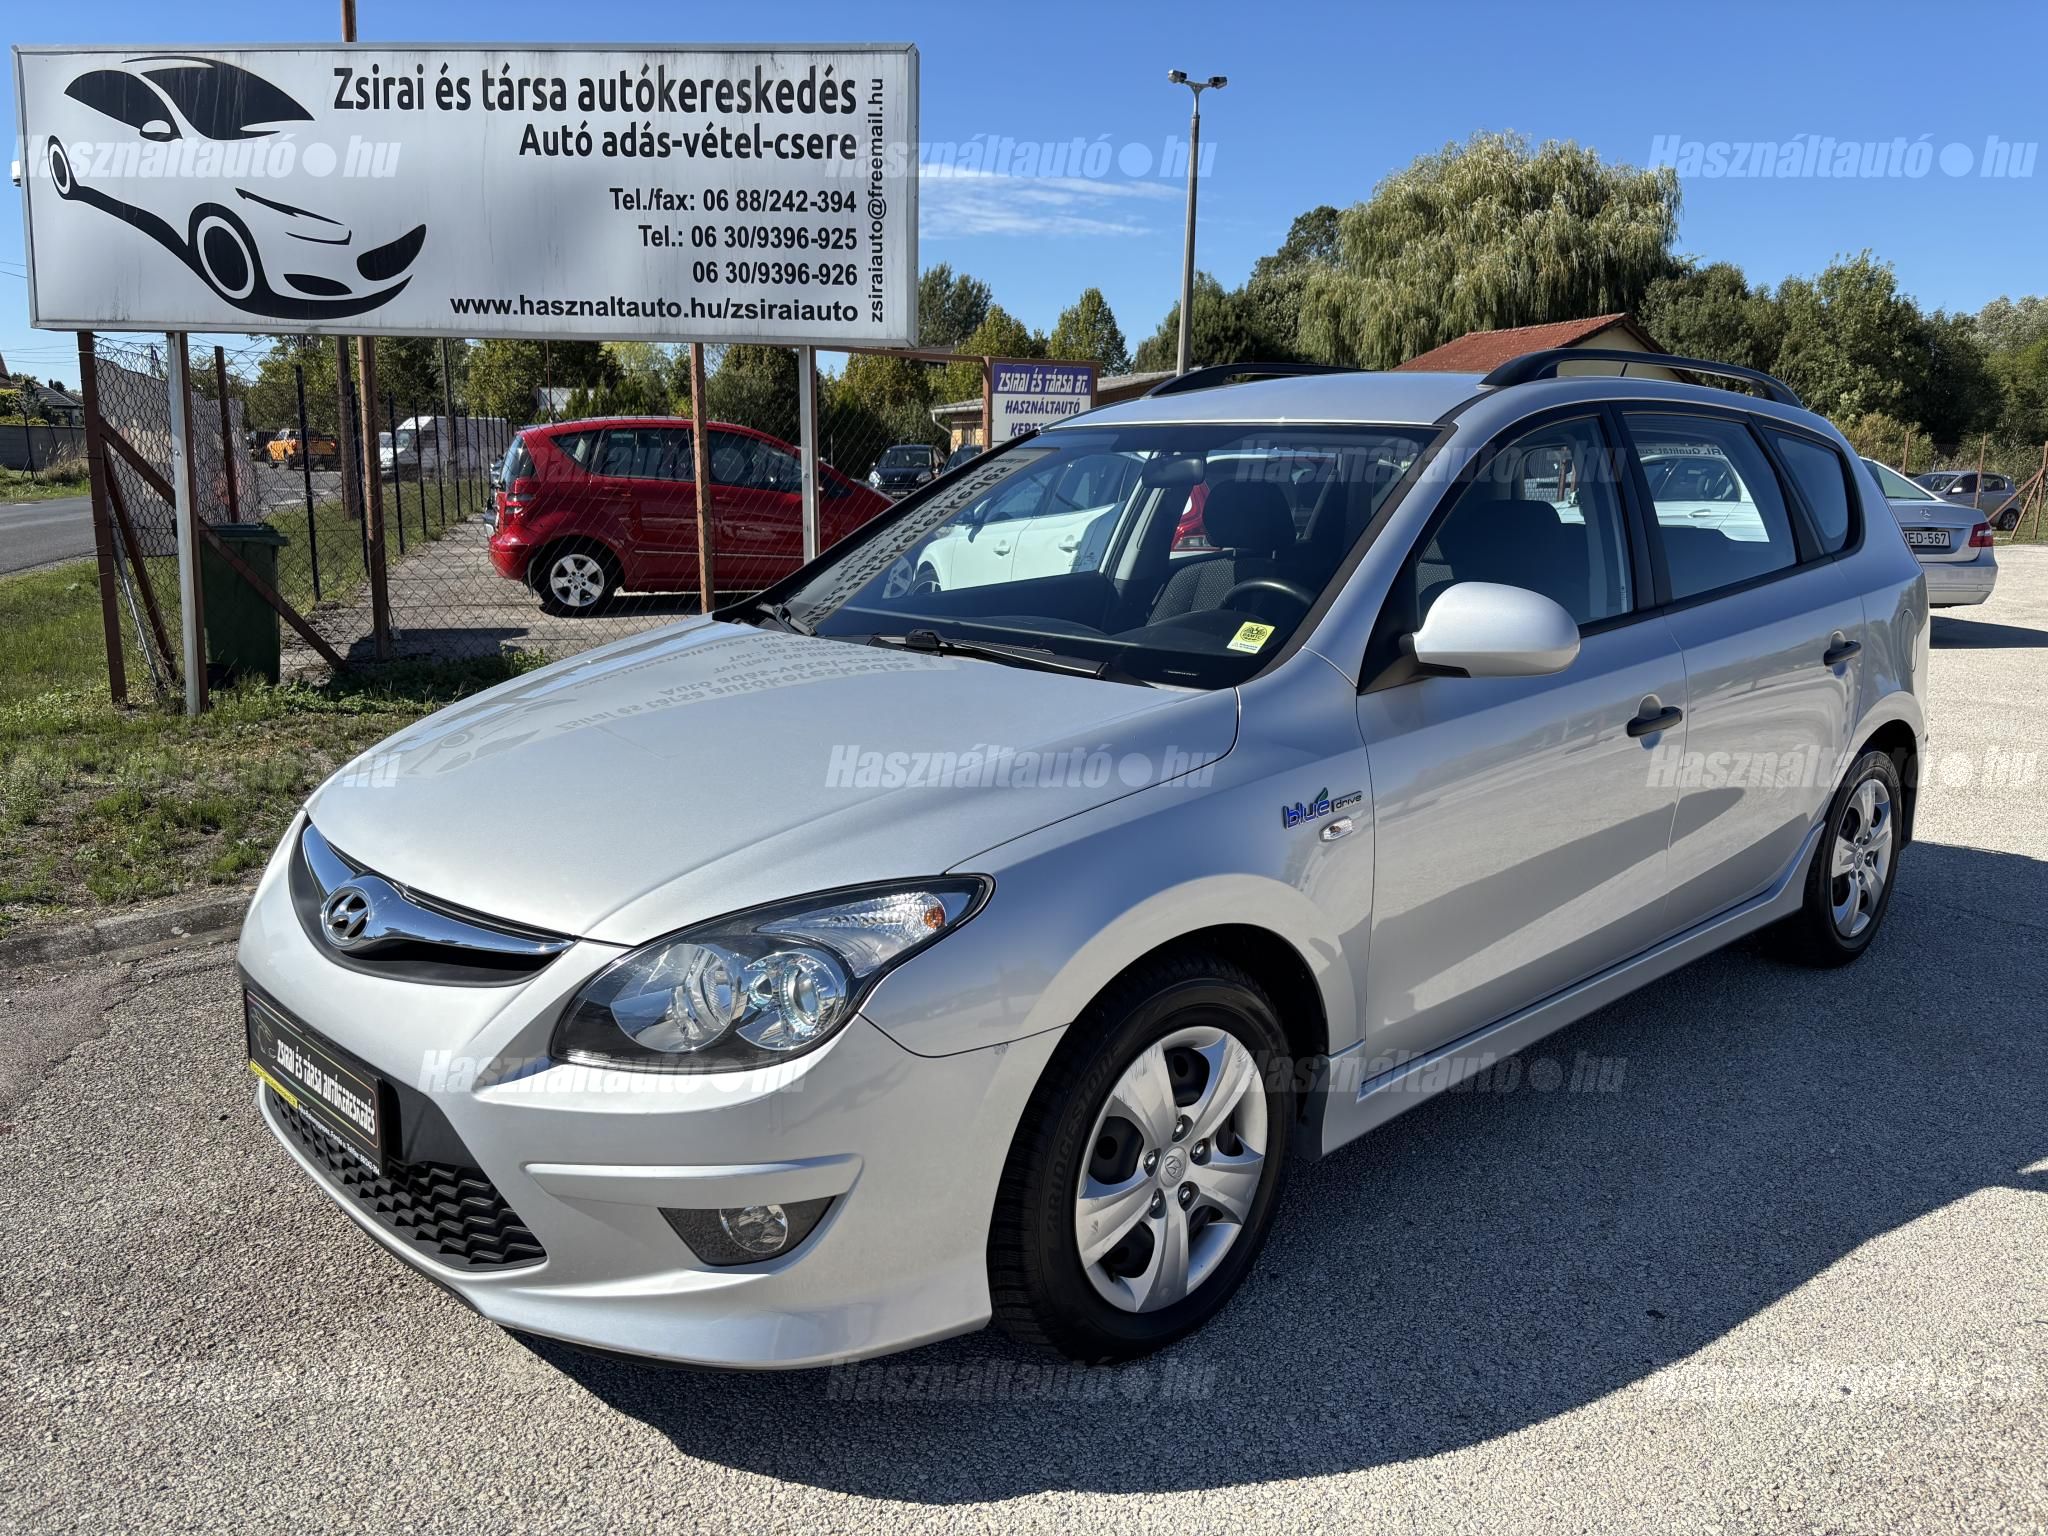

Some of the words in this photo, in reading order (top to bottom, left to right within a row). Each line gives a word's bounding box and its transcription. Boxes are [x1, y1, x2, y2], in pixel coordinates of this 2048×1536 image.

[334, 63, 425, 110] Zsirai
[436, 62, 472, 111] és
[482, 62, 567, 112] társa
[578, 62, 857, 114] autókereskedés
[519, 120, 593, 157] Autó
[601, 120, 857, 160] adás-vétel-csere
[610, 187, 696, 213] Tel./fax:
[703, 189, 730, 212] 06
[736, 189, 857, 214] 88/242-394
[867, 78, 887, 323] zsiraiauto@freemail.hu
[638, 224, 684, 248] Tel.:
[691, 225, 717, 248] 06
[724, 225, 858, 250] 30/9396-925
[692, 261, 719, 285] 06
[725, 261, 858, 286] 30/9396-926
[450, 294, 859, 323] www.hasznaltauto.hu/zsiraiauto
[998, 372, 1030, 392] ZSIRAI
[1031, 367, 1042, 393] ÉS
[1005, 397, 1080, 415] HASZNÁLTAUTÓ
[1282, 799, 1330, 829] blue
[1335, 794, 1363, 809] drive
